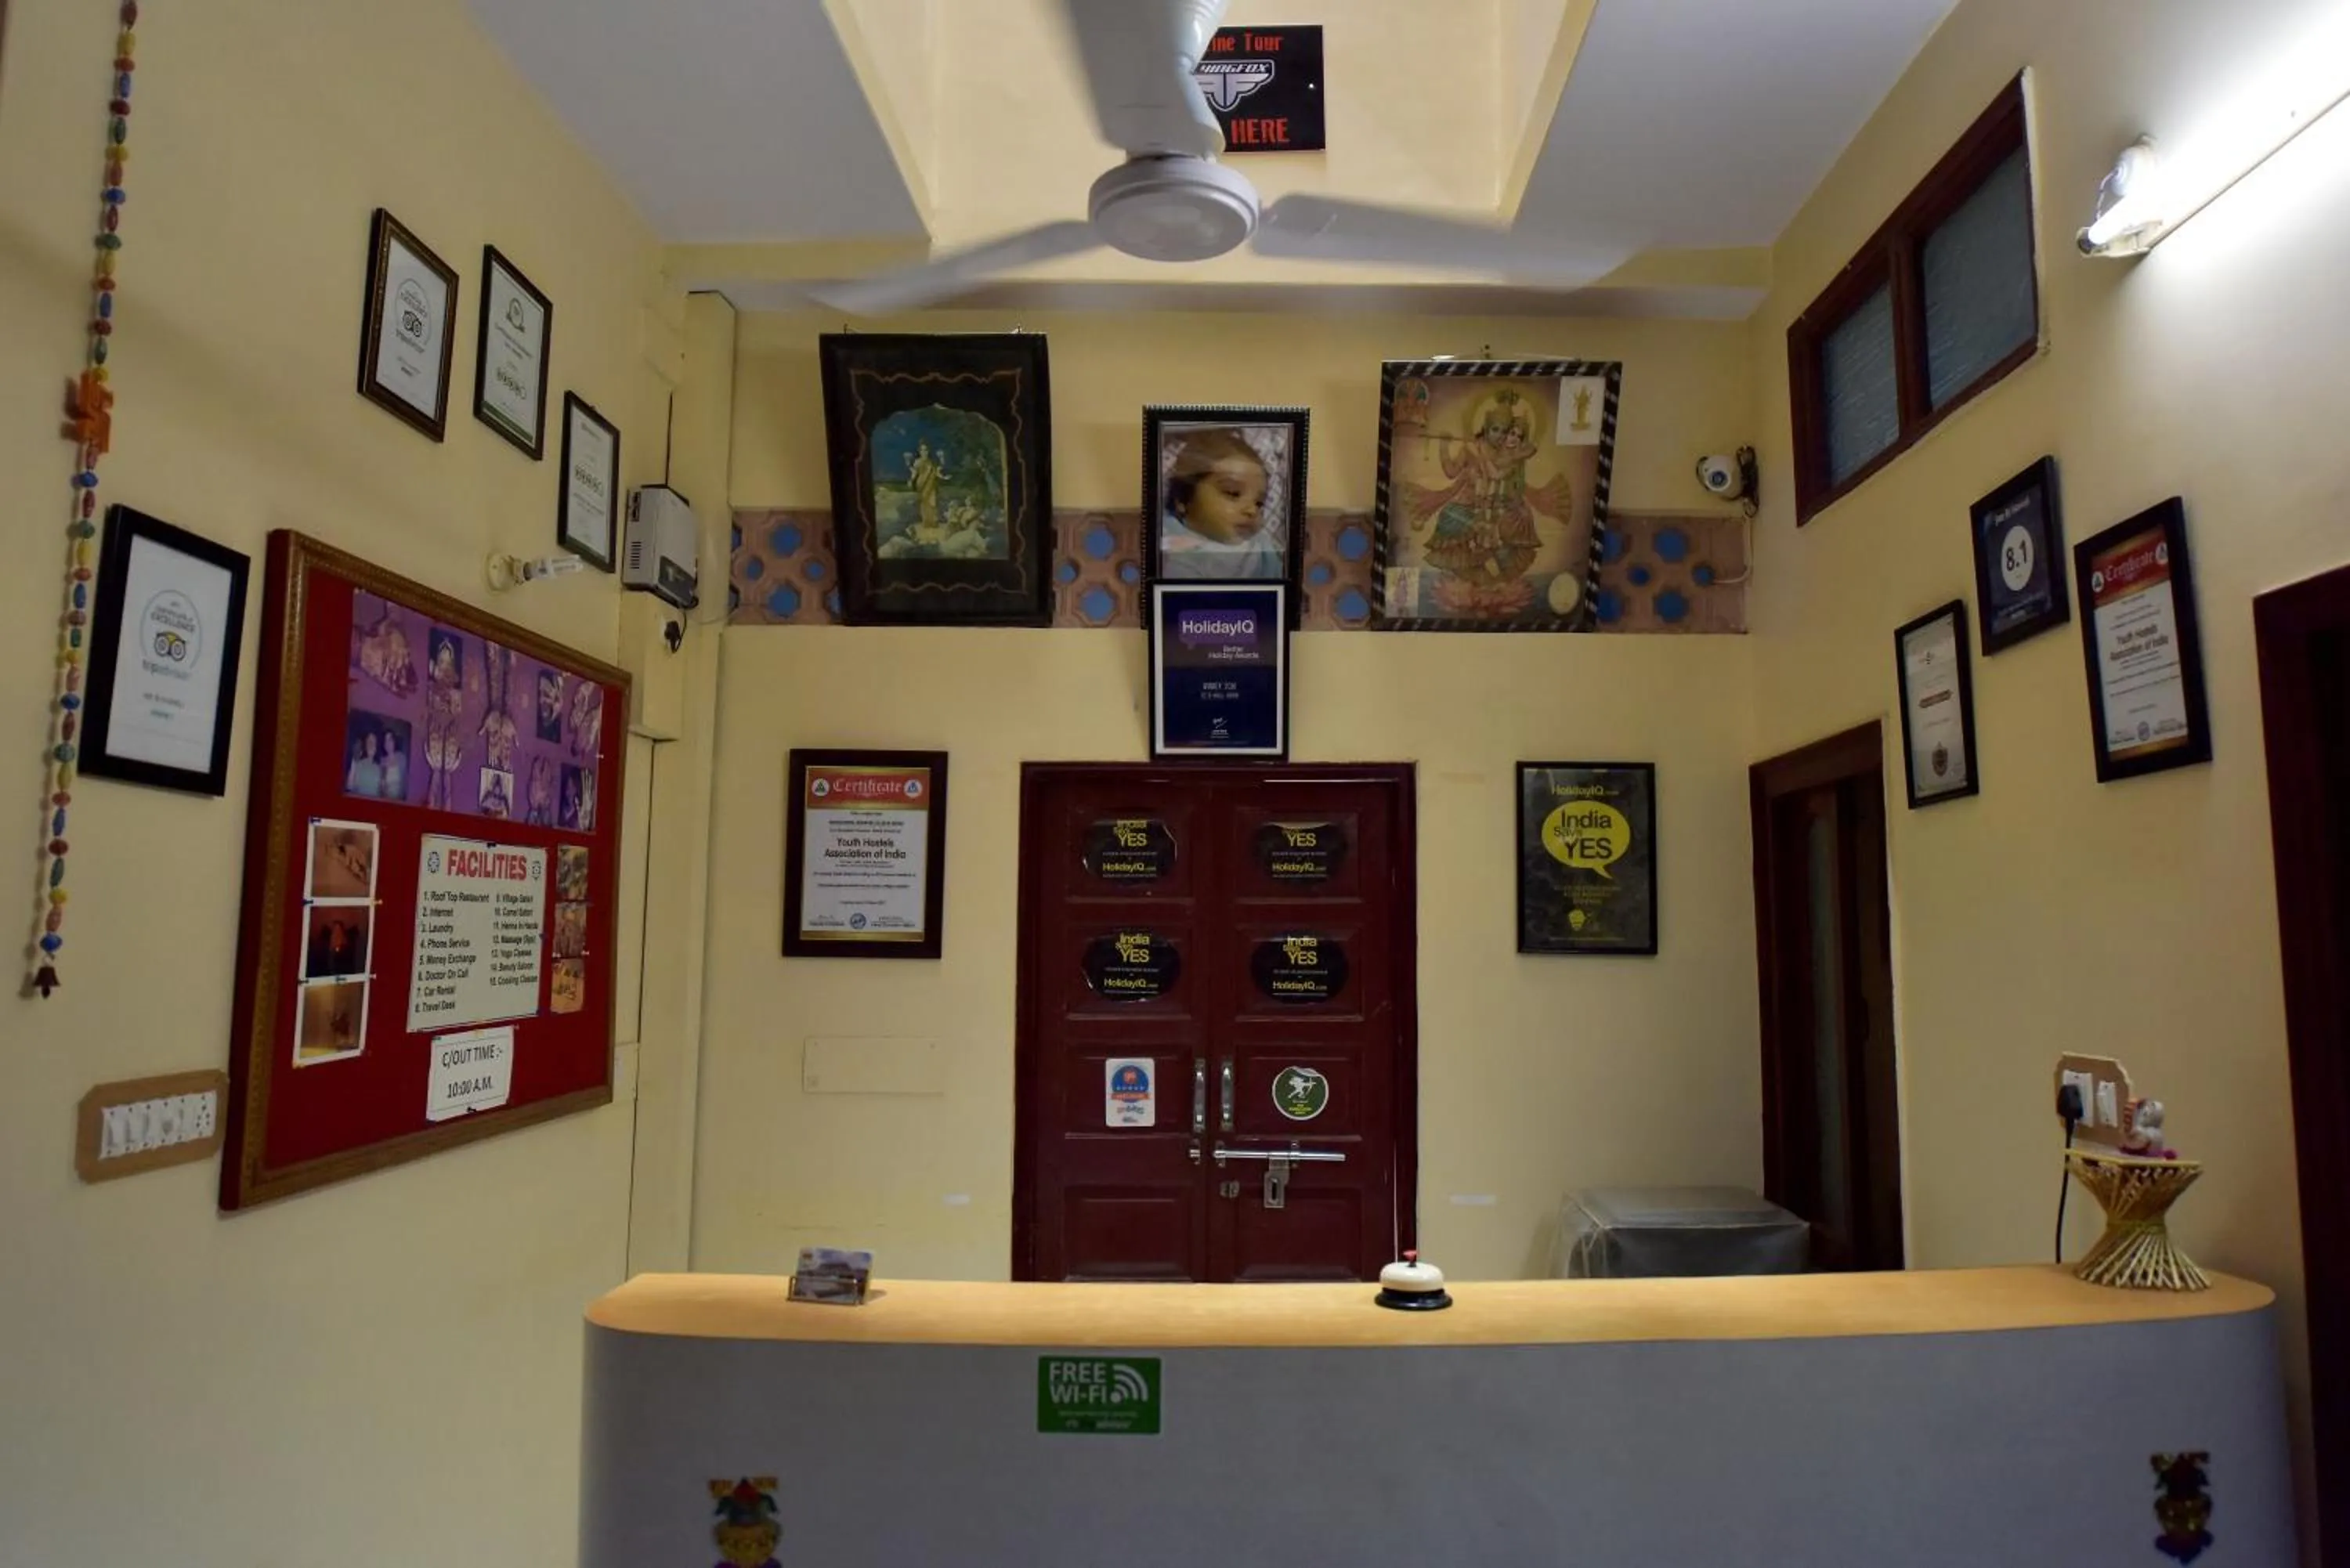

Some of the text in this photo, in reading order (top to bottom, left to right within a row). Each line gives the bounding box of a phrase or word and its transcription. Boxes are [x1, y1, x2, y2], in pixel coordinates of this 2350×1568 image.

[1244, 33, 1285, 51] Tour
[1231, 118, 1290, 144] HERE
[2006, 539, 2027, 572] 8.1
[1181, 620, 1254, 636] HolidayIQ
[833, 778, 902, 793] Certificate
[1561, 808, 1612, 829] India
[837, 837, 894, 847] Youth Hostels
[1118, 833, 1148, 847] YES
[1287, 833, 1317, 847] YES
[825, 848, 906, 859] Association of India
[1564, 837, 1613, 860] YES
[447, 849, 527, 881] FACILITIES
[445, 891, 457, 903] Top
[428, 923, 454, 934] Laundry
[427, 938, 447, 948] Phone
[449, 938, 470, 948] Service
[1120, 932, 1150, 945] India
[1287, 934, 1317, 947] India
[447, 954, 476, 965] Exchange
[1120, 948, 1150, 963] YES
[1288, 951, 1318, 965] YES
[425, 970, 446, 981] Doctor
[424, 987, 435, 997] Car
[422, 1002, 440, 1013] Travel
[442, 1049, 472, 1069] C/OUT
[473, 1044, 495, 1061] TIME
[447, 1078, 472, 1099] 10:00
[1049, 1361, 1107, 1384] FREE
[1049, 1384, 1107, 1404] WI-FI
